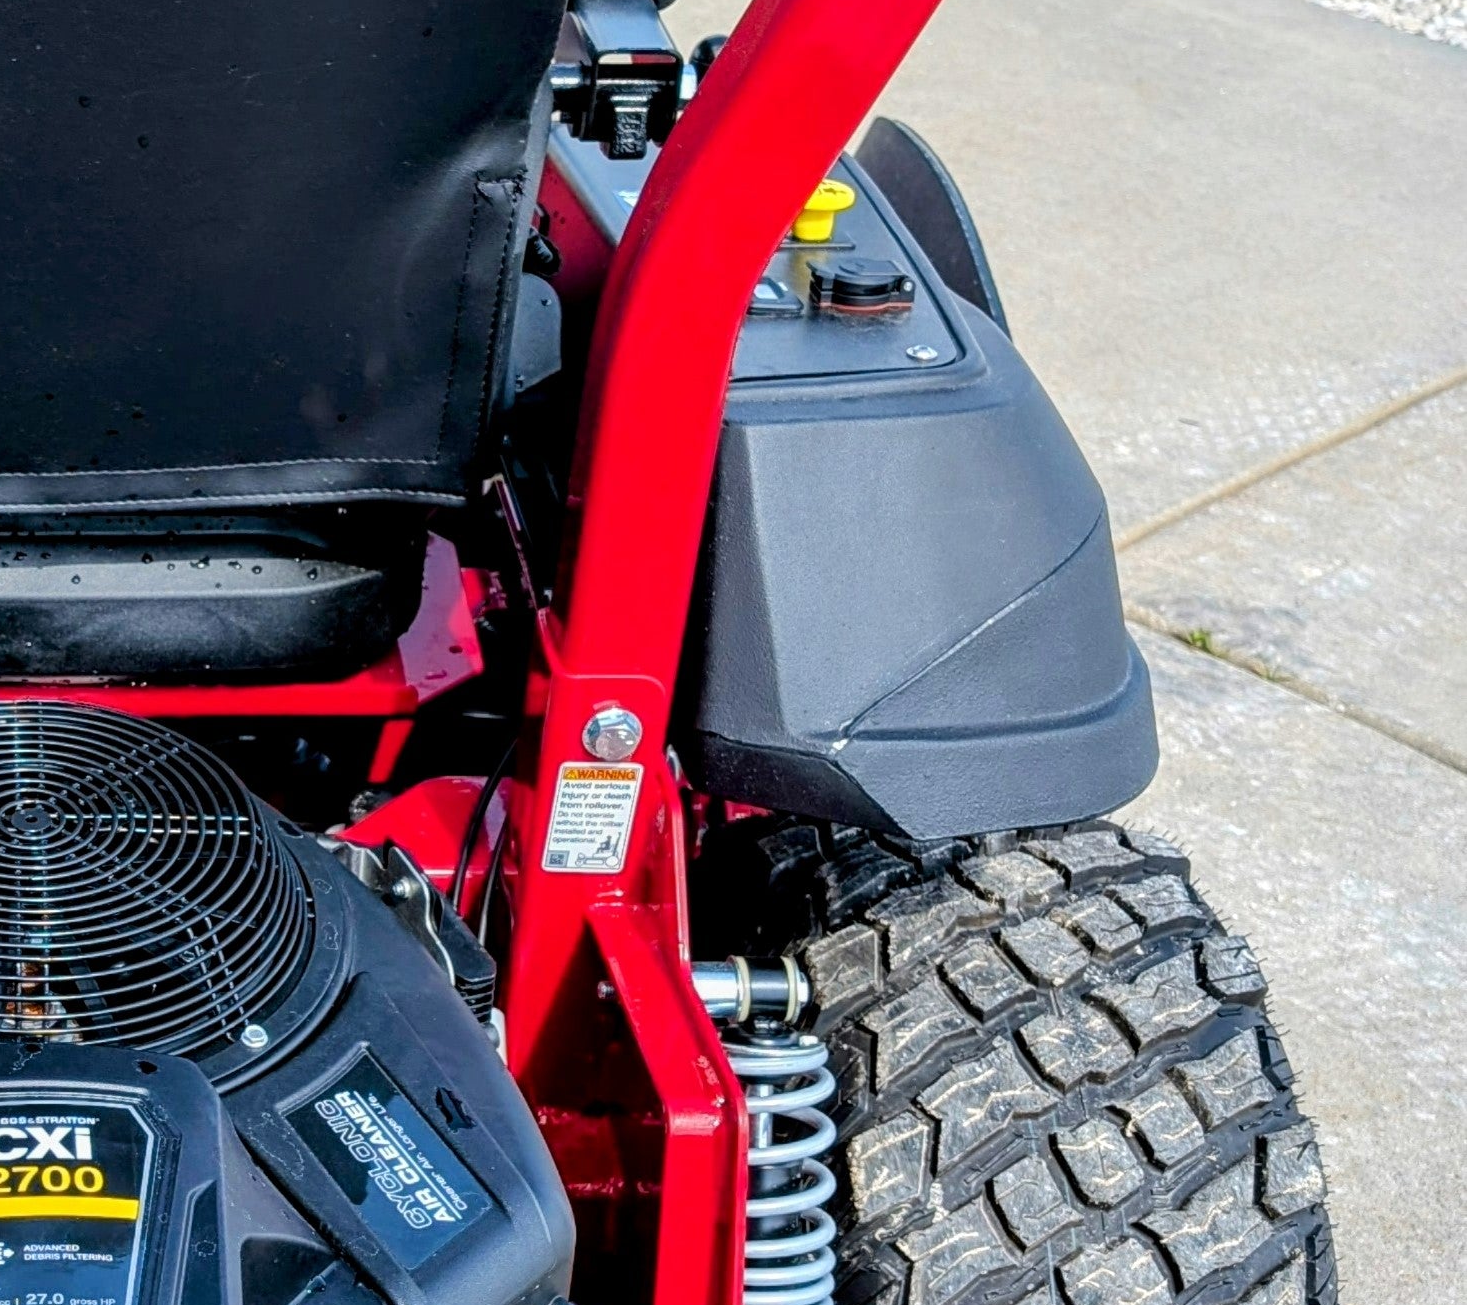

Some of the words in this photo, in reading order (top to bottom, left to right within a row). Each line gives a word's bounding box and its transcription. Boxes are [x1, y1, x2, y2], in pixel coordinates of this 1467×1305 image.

[578, 770, 635, 780] WARNING
[335, 1091, 420, 1184] CLEANER
[385, 1115, 417, 1149] Longer
[315, 1100, 431, 1230] CYCLONIC
[415, 1189, 456, 1222] AIR
[430, 1171, 467, 1210] Cleaner
[25, 1293, 64, 1305] 27.0
[70, 1298, 97, 1305] gross
